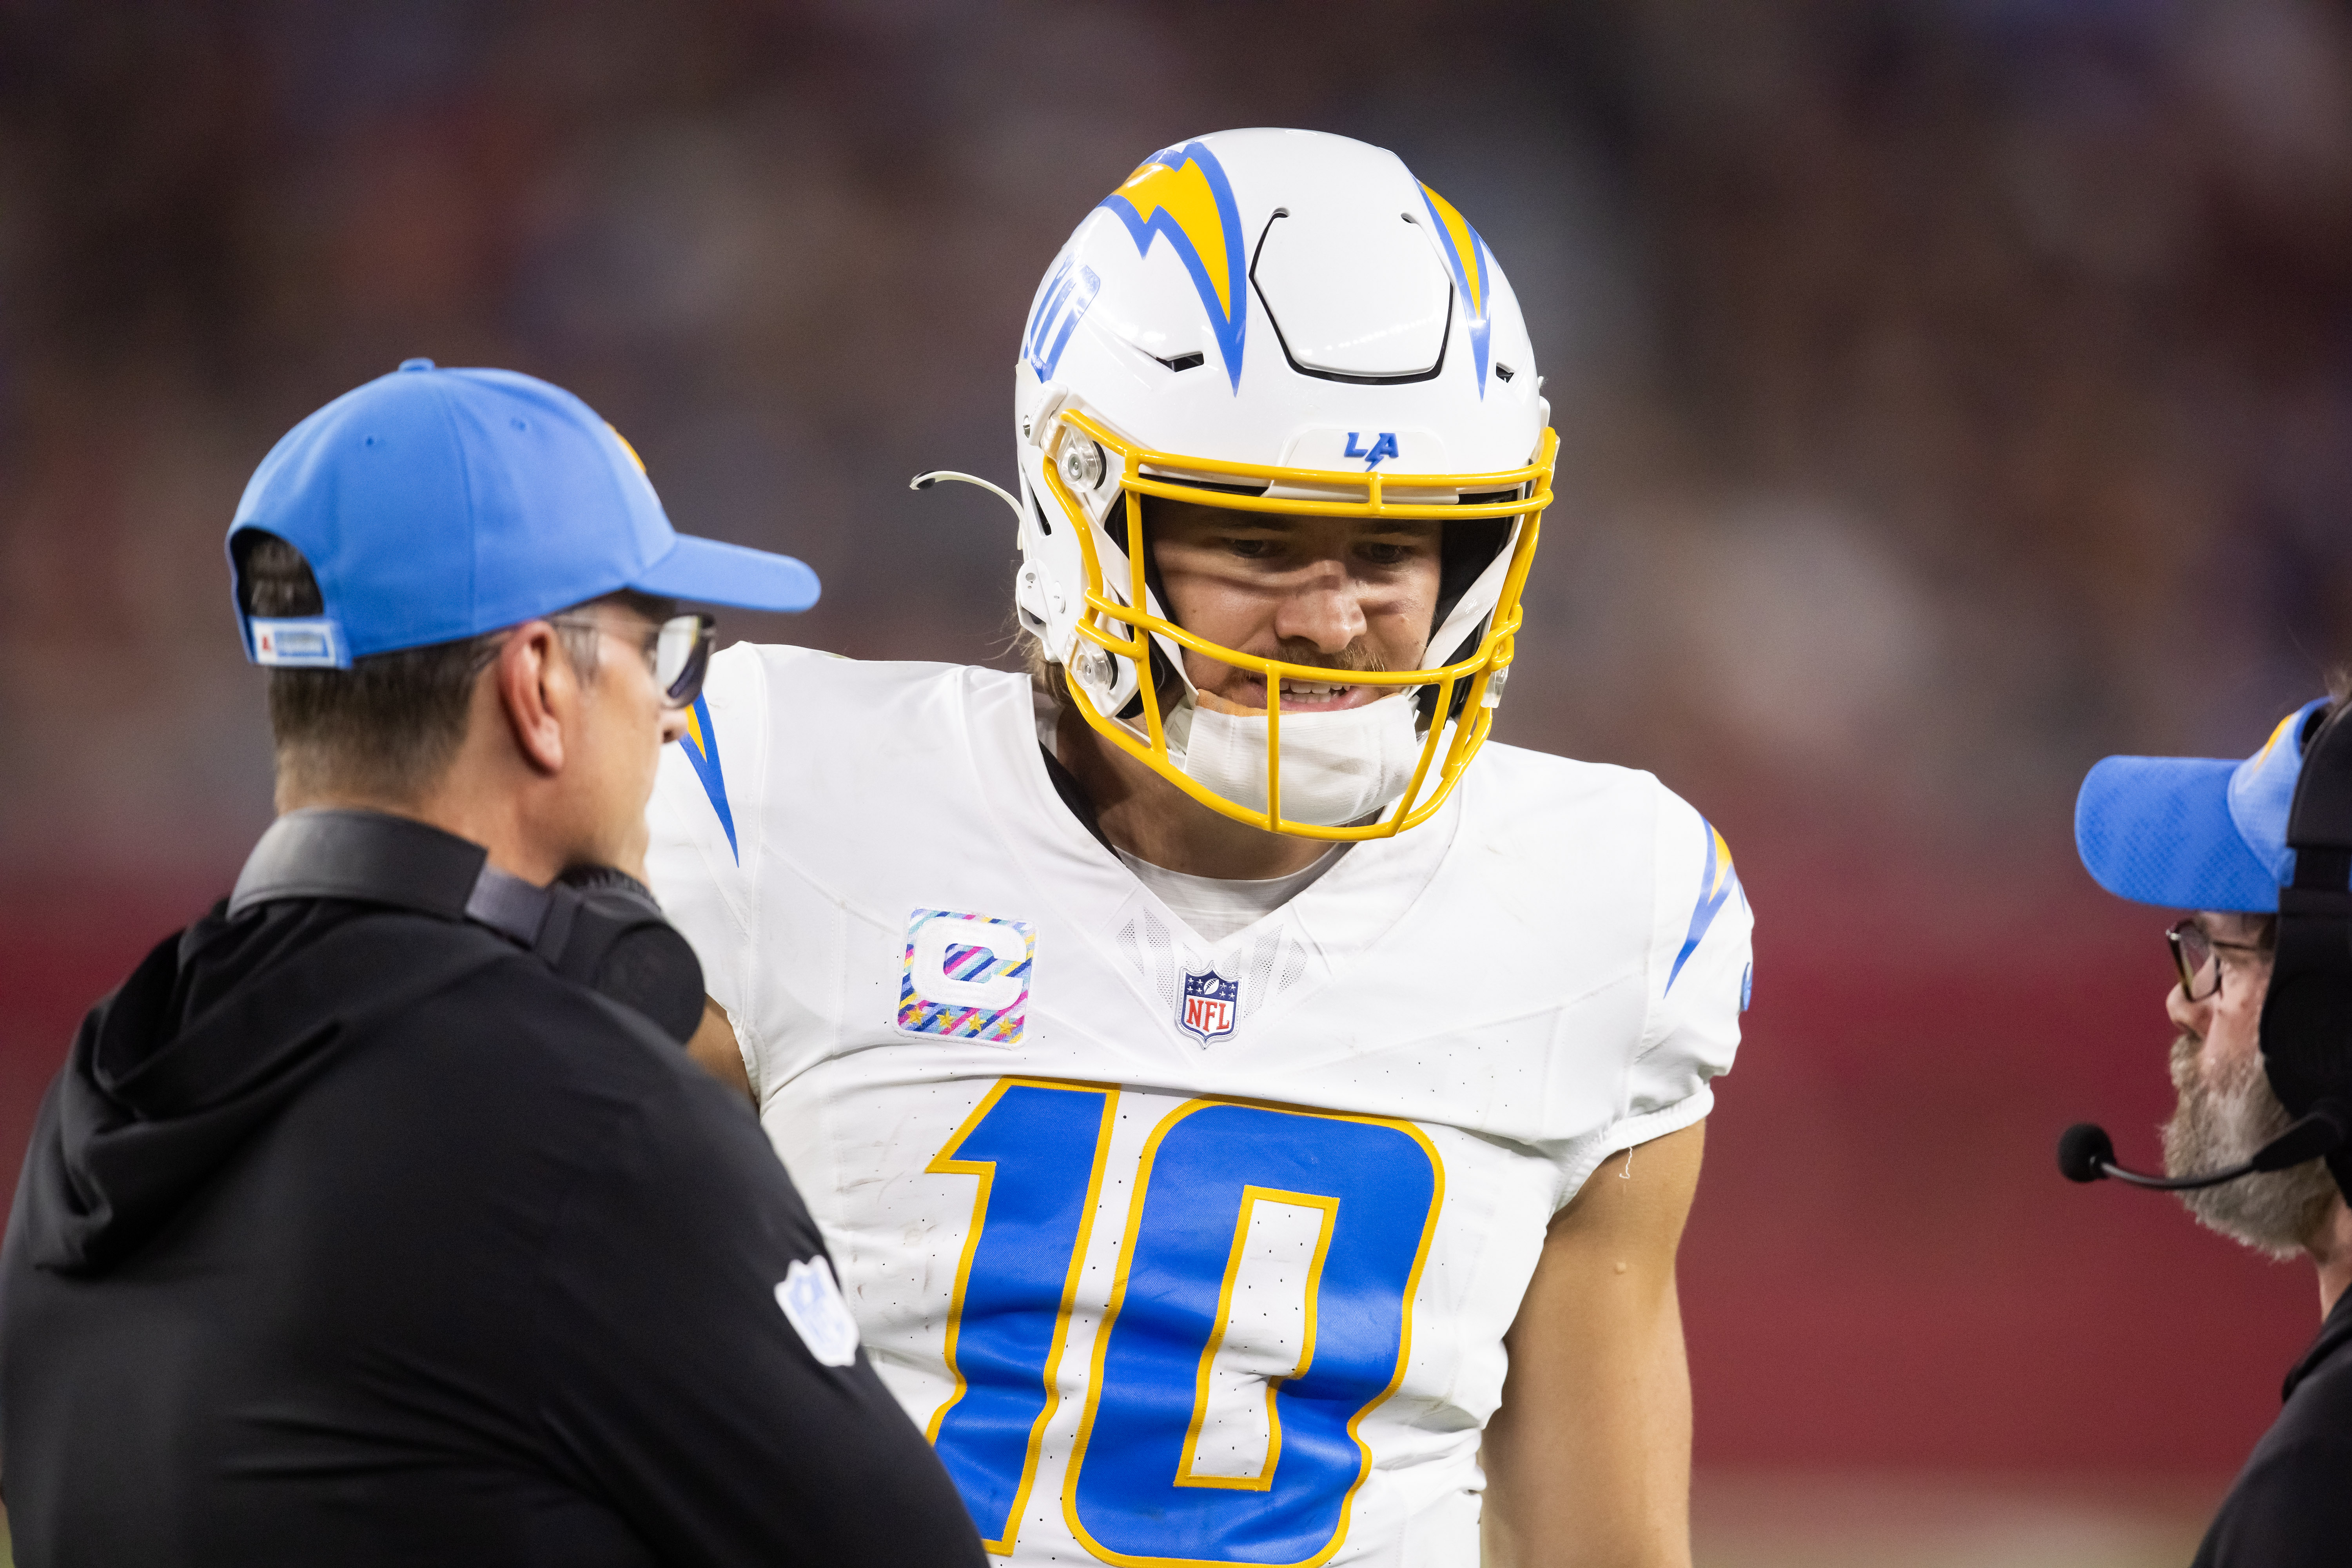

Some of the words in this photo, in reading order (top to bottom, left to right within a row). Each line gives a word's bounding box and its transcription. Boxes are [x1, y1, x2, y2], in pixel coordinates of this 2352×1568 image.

[1344, 432, 1399, 472] LA
[911, 917, 1027, 1011] C
[1186, 998, 1229, 1032] NFL
[924, 1074, 1445, 1568] 10
